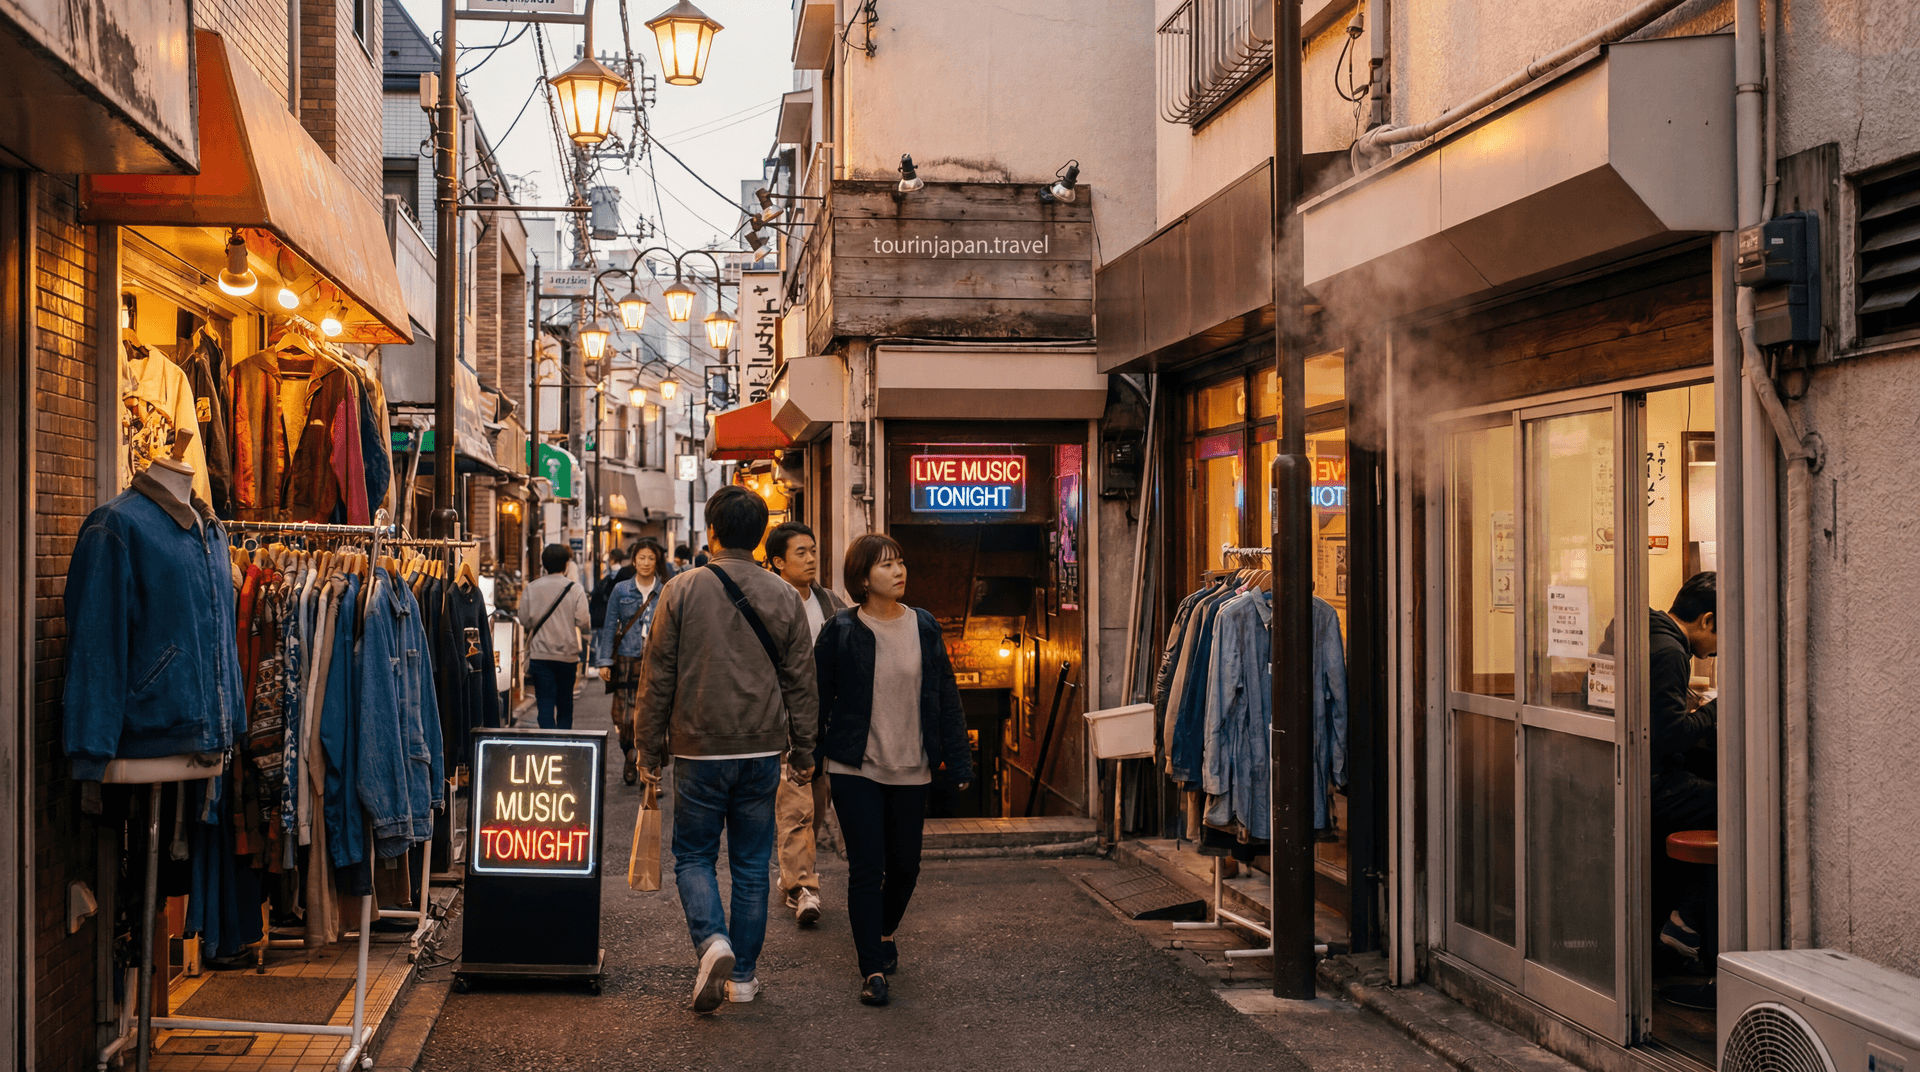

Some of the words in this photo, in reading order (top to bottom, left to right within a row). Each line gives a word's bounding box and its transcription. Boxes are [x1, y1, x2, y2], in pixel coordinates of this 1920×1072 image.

[916, 461, 957, 481] LIVE
[961, 461, 1021, 482] MUSIC
[926, 486, 1011, 506] TONIGHT
[510, 754, 563, 785] LIVE
[496, 791, 576, 823] MUSIC
[481, 829, 588, 861] TONIGHT
